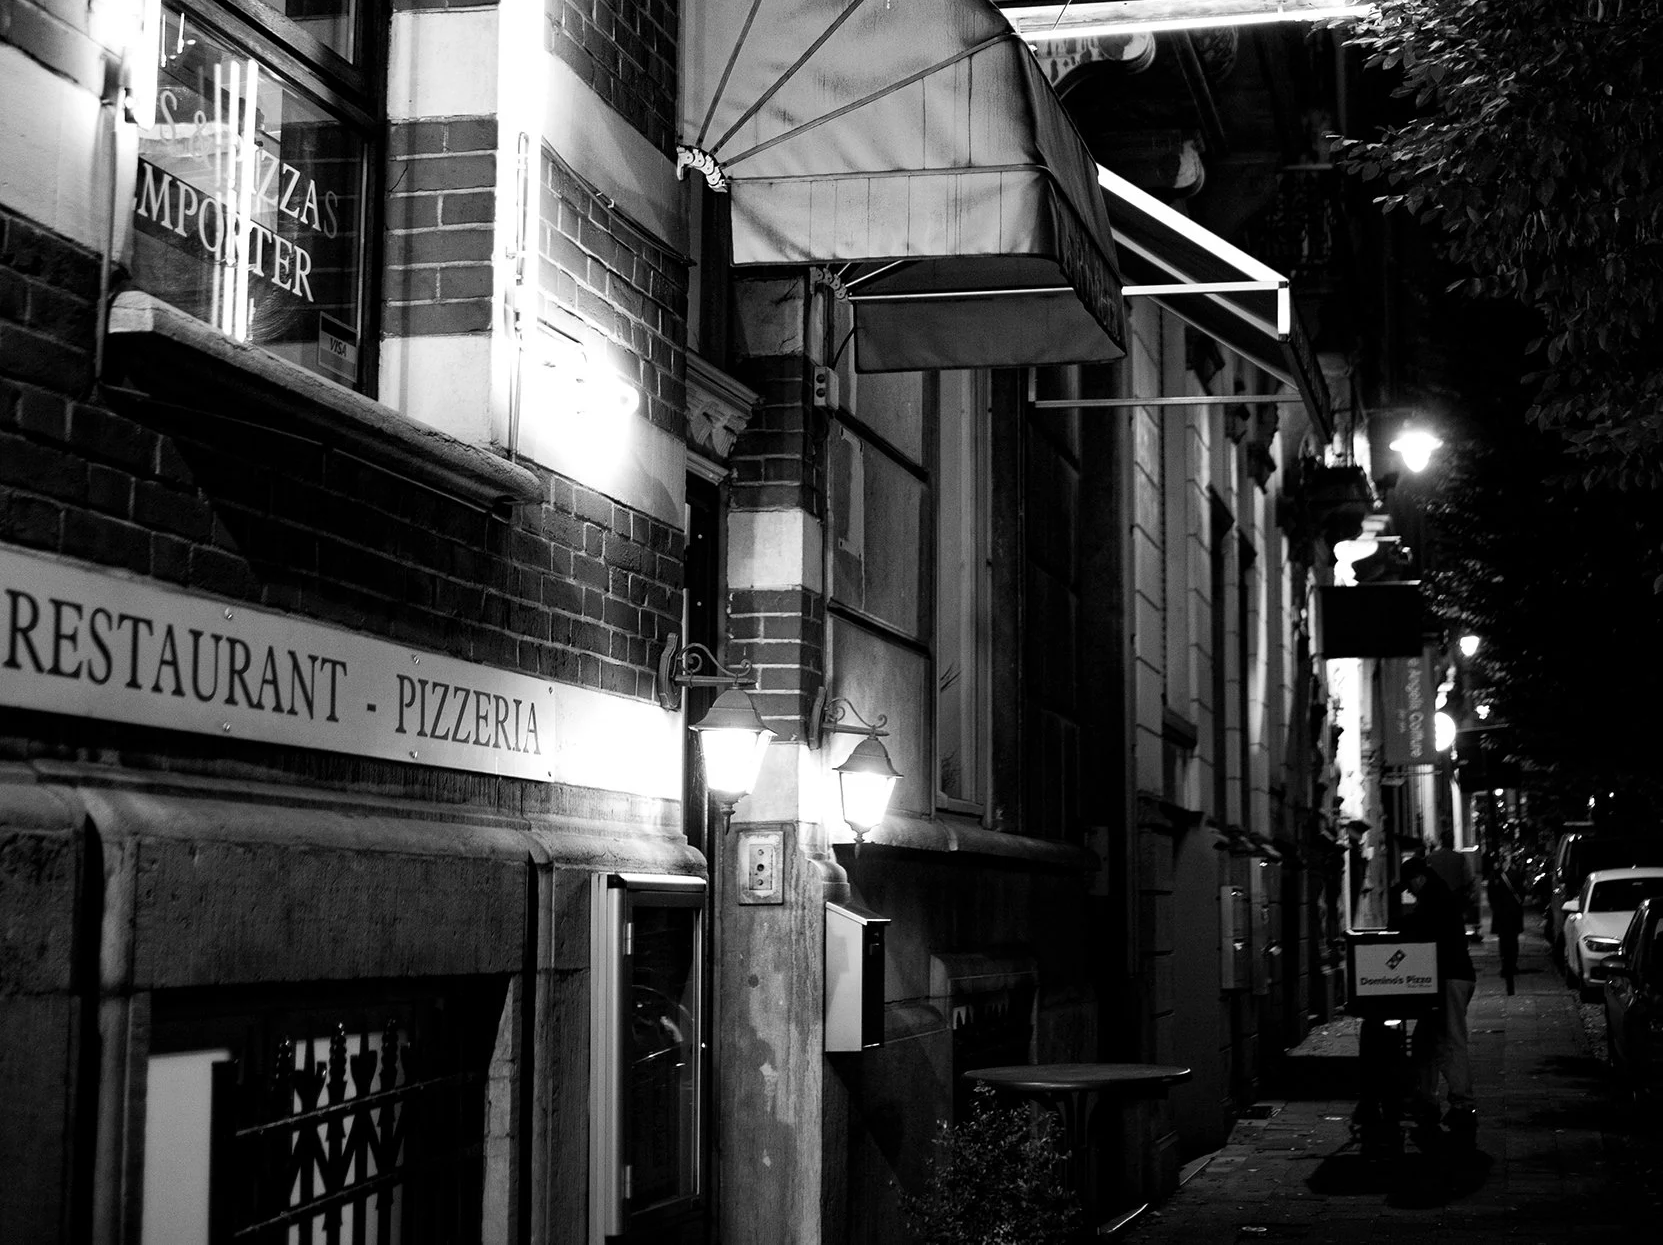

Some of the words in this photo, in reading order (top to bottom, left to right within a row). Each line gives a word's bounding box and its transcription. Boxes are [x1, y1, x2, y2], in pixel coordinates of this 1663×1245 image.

[133, 161, 314, 302] MPORTER
[329, 337, 348, 357] VISA
[3, 588, 348, 723] RESTAURANT
[395, 673, 542, 755] PIZZERIA
[1360, 975, 1404, 986] Domino's
[1406, 975, 1432, 984] Pizza
